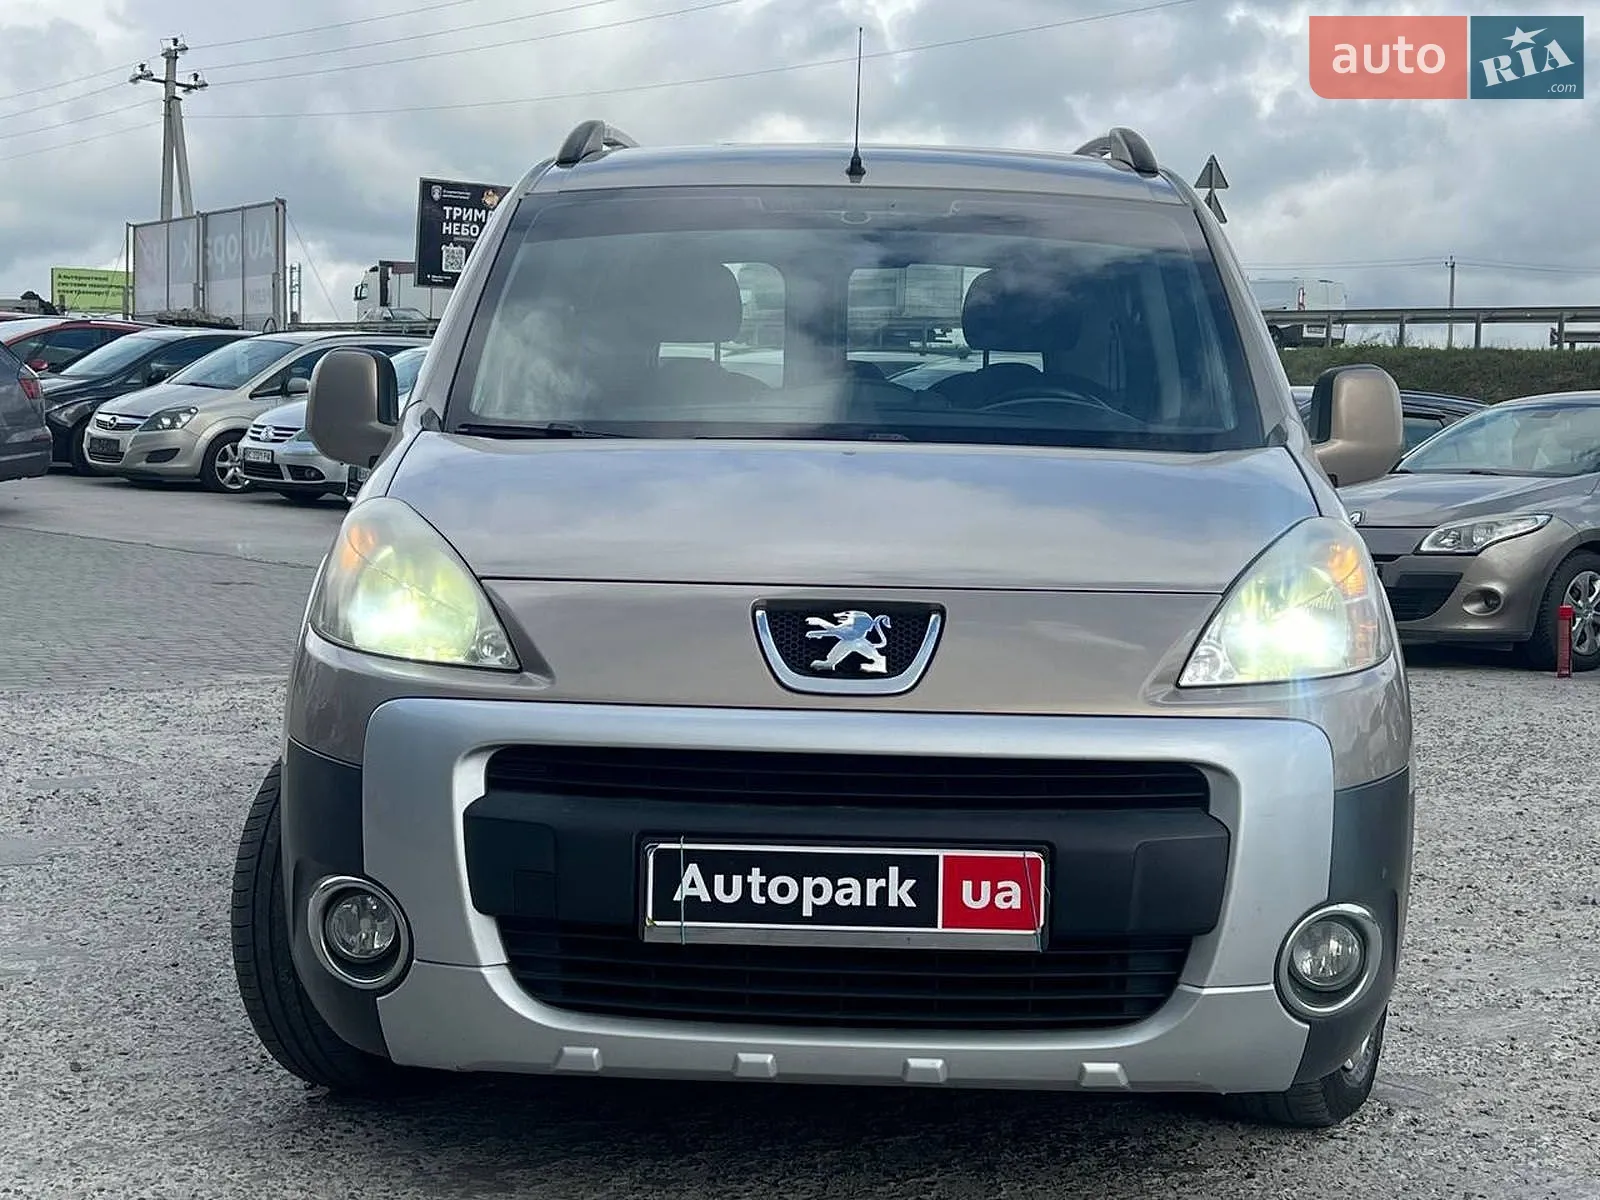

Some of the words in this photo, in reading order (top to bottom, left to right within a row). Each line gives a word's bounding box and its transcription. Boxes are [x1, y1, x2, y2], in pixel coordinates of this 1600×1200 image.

[442, 222, 479, 237] НЕБО
[673, 863, 917, 917] Autopark
[961, 879, 1021, 910] ua
